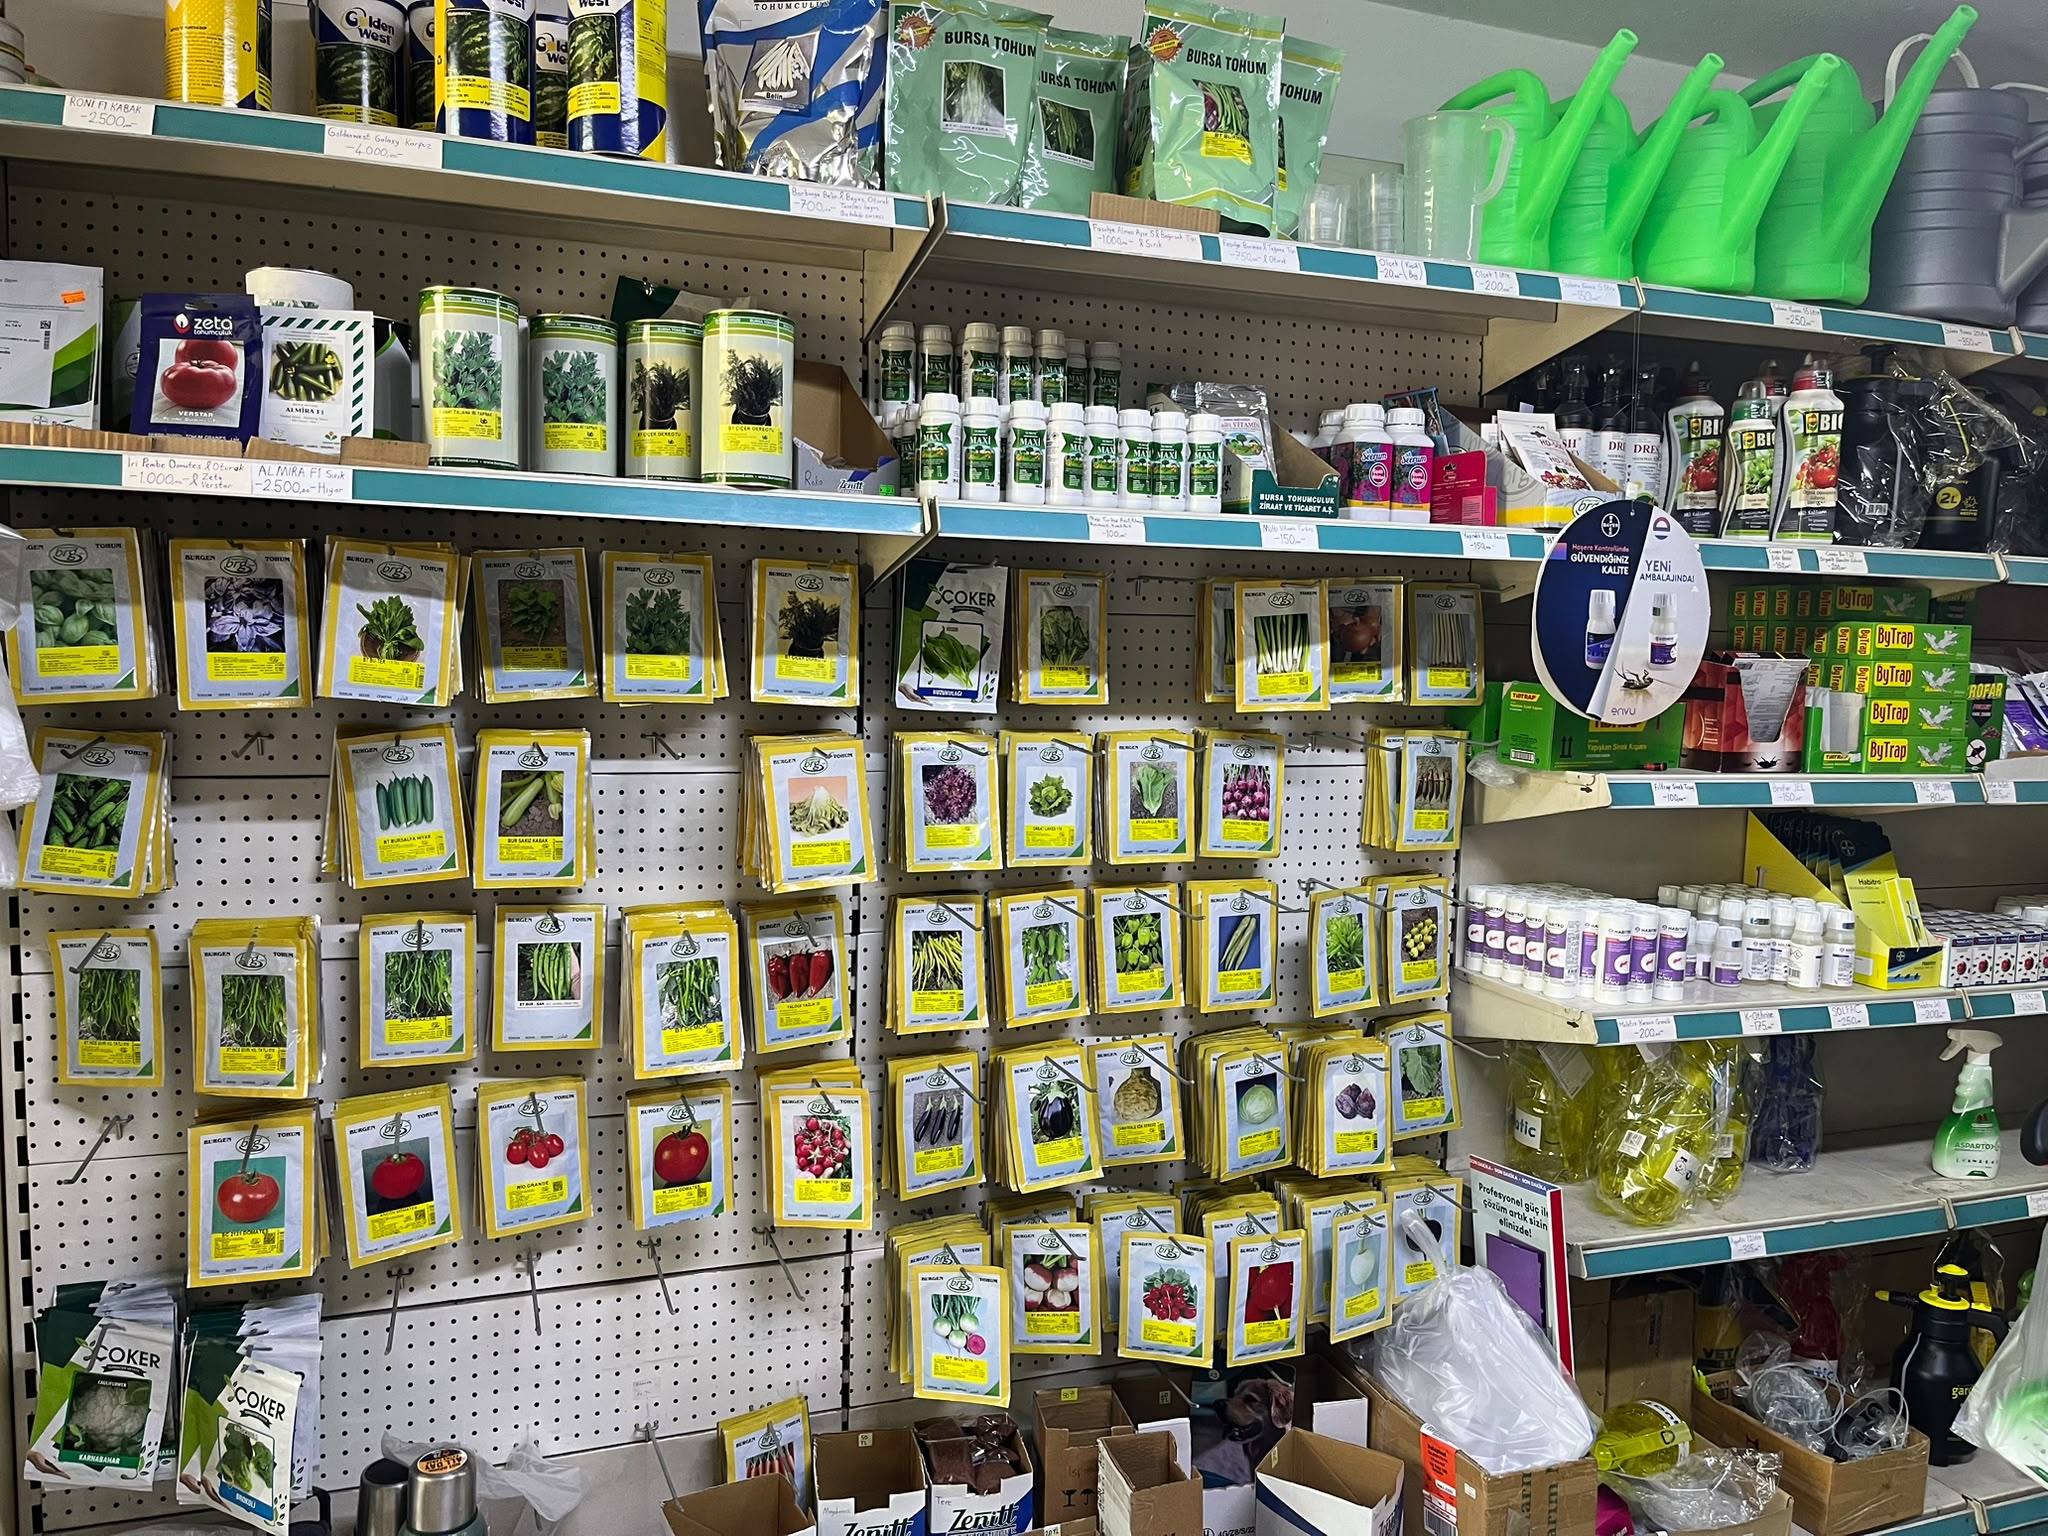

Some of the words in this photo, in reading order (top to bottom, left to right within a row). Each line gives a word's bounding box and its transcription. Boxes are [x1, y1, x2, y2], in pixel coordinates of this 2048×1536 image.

[345, 7, 394, 34] Golden
[358, 27, 393, 46] West
[944, 31, 992, 52] BURSA
[1186, 48, 1223, 69] BURSA
[1225, 57, 1268, 76] TOHUM
[1074, 77, 1117, 95] TOHUM
[1280, 83, 1323, 105] TOHUM
[110, 102, 142, 115] KABAK
[193, 315, 233, 330] zeta
[178, 410, 214, 420] VERSTAR
[142, 458, 165, 470] Pembe
[169, 460, 202, 472] Domates
[1258, 501, 1284, 513] ZİRAAT
[1284, 503, 1293, 513] VE
[1294, 504, 1321, 516] TİCARET
[1259, 494, 1285, 505] BURSA
[1287, 495, 1336, 508] TOHUMCULUK
[1570, 552, 1630, 566] GÜVENDİĞİNİZ
[1645, 559, 1673, 573] YENİ
[1601, 565, 1630, 576] KALİTE
[1639, 572, 1695, 584] AMBALAJINDA!
[1837, 588, 1874, 611] ByTrap
[1876, 626, 1914, 649] ByTrap
[1876, 664, 1912, 687] ByTrap
[1610, 706, 1637, 717] envu
[1872, 701, 1909, 725] ByTrap
[1869, 735, 1907, 762] ByTrap
[1858, 878, 1882, 886] Habitro
[1832, 1004, 1862, 1017] SOLFAC
[1478, 1182, 1523, 1208] Profesyonel
[1524, 1201, 1540, 1216] güç
[1482, 1197, 1510, 1214] çözüm
[1509, 1209, 1528, 1224] artık
[1529, 1216, 1548, 1231] sizin
[1498, 1217, 1533, 1239] elinizde!
[79, 1454, 121, 1466] KARNABAHAR
[951, 1503, 1020, 1531] Zenitt
